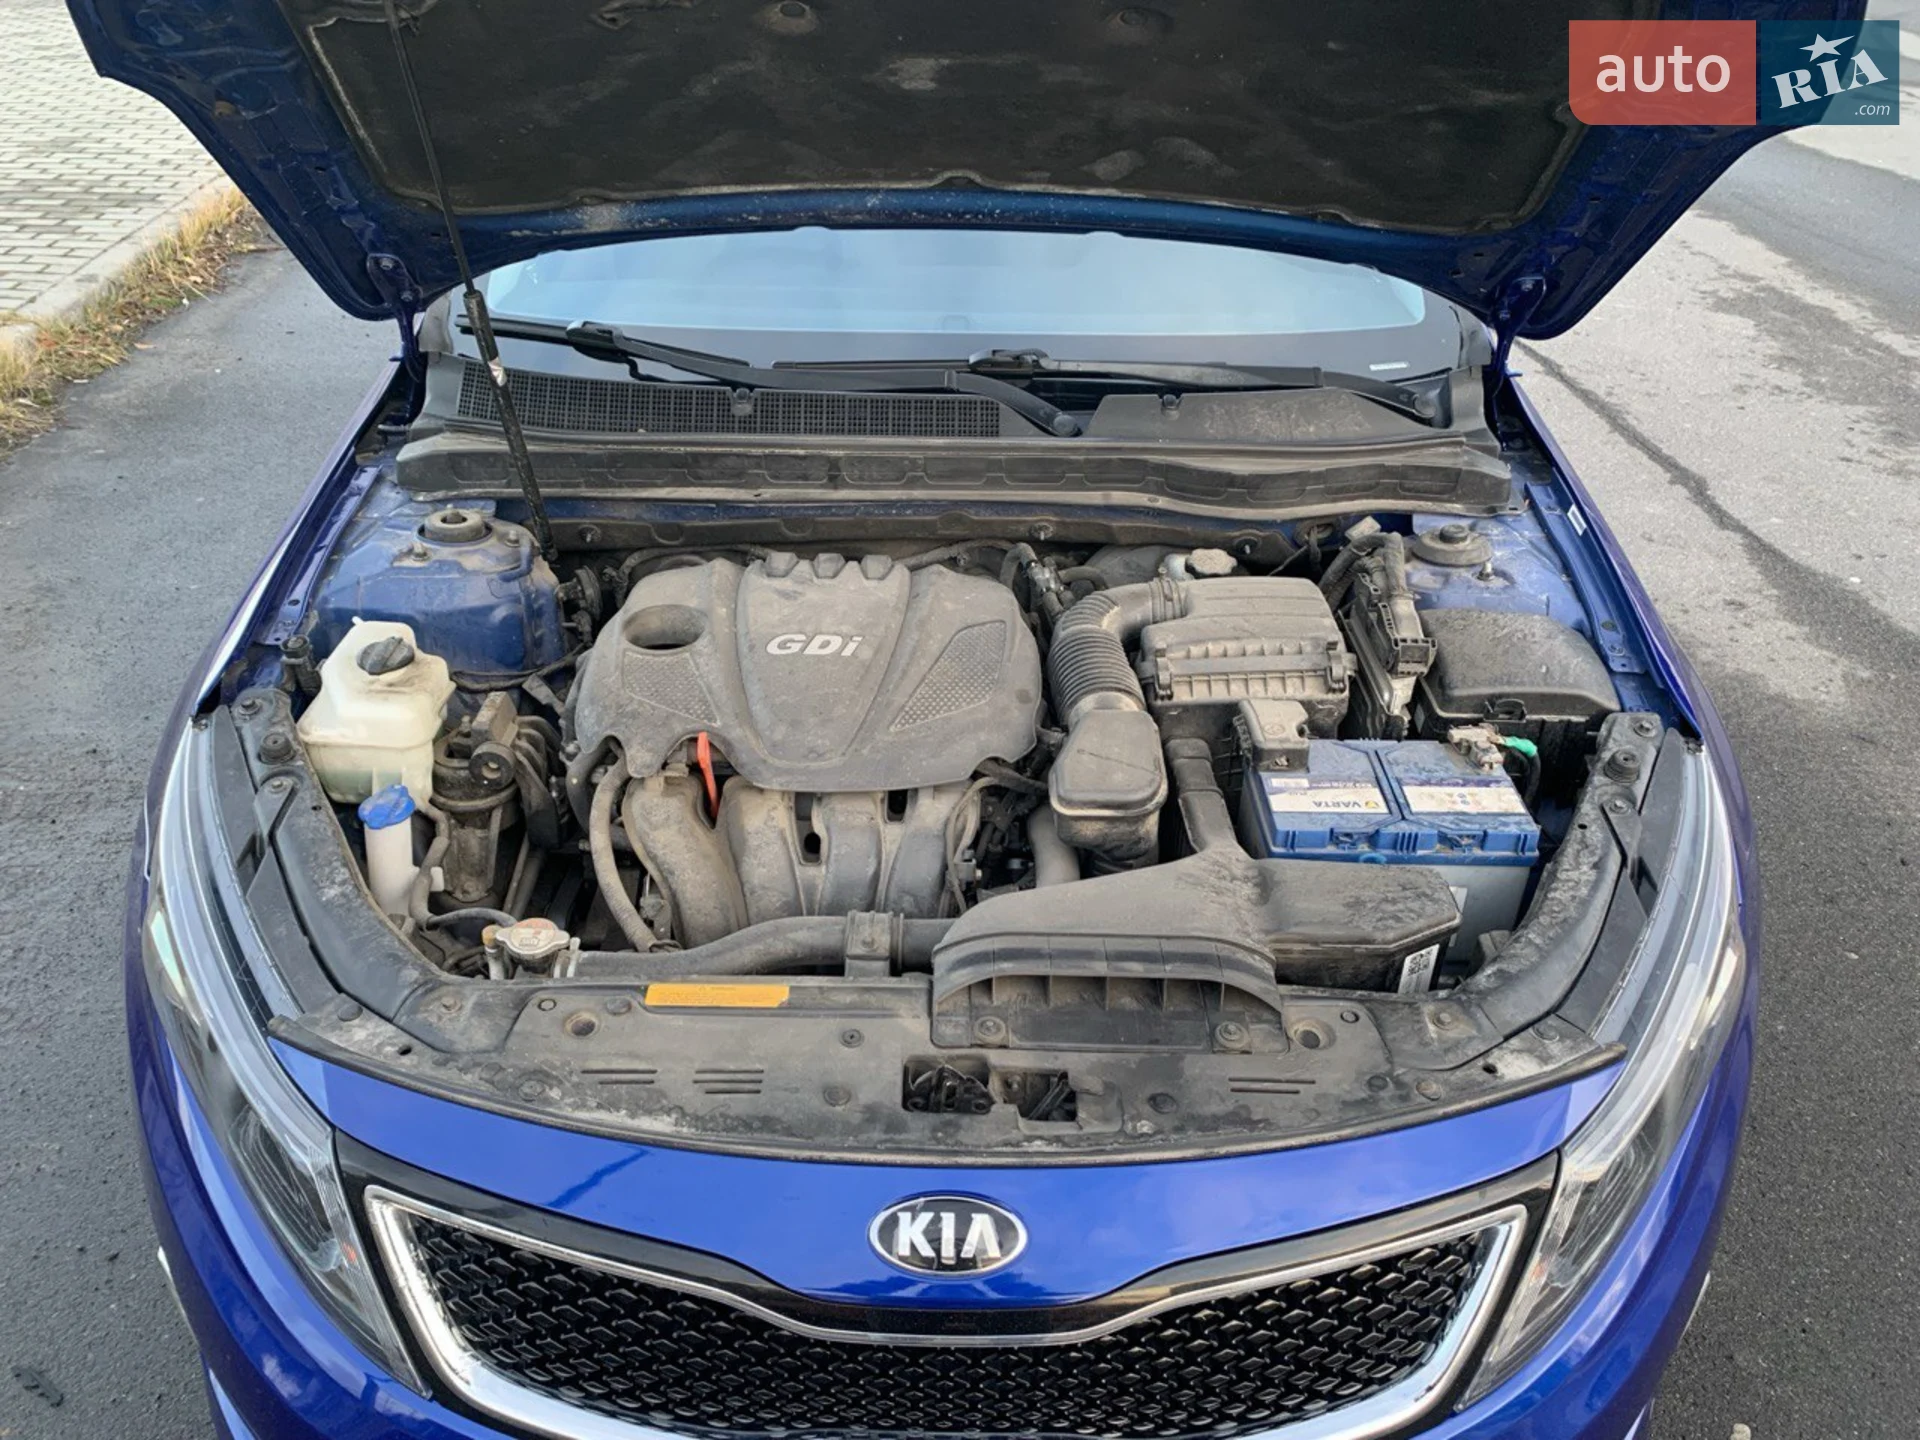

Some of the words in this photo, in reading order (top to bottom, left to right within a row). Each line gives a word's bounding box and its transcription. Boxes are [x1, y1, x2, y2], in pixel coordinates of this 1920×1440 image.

[766, 633, 863, 656] GDi
[1312, 800, 1361, 808] VARTA
[896, 1211, 1001, 1261] KIA
